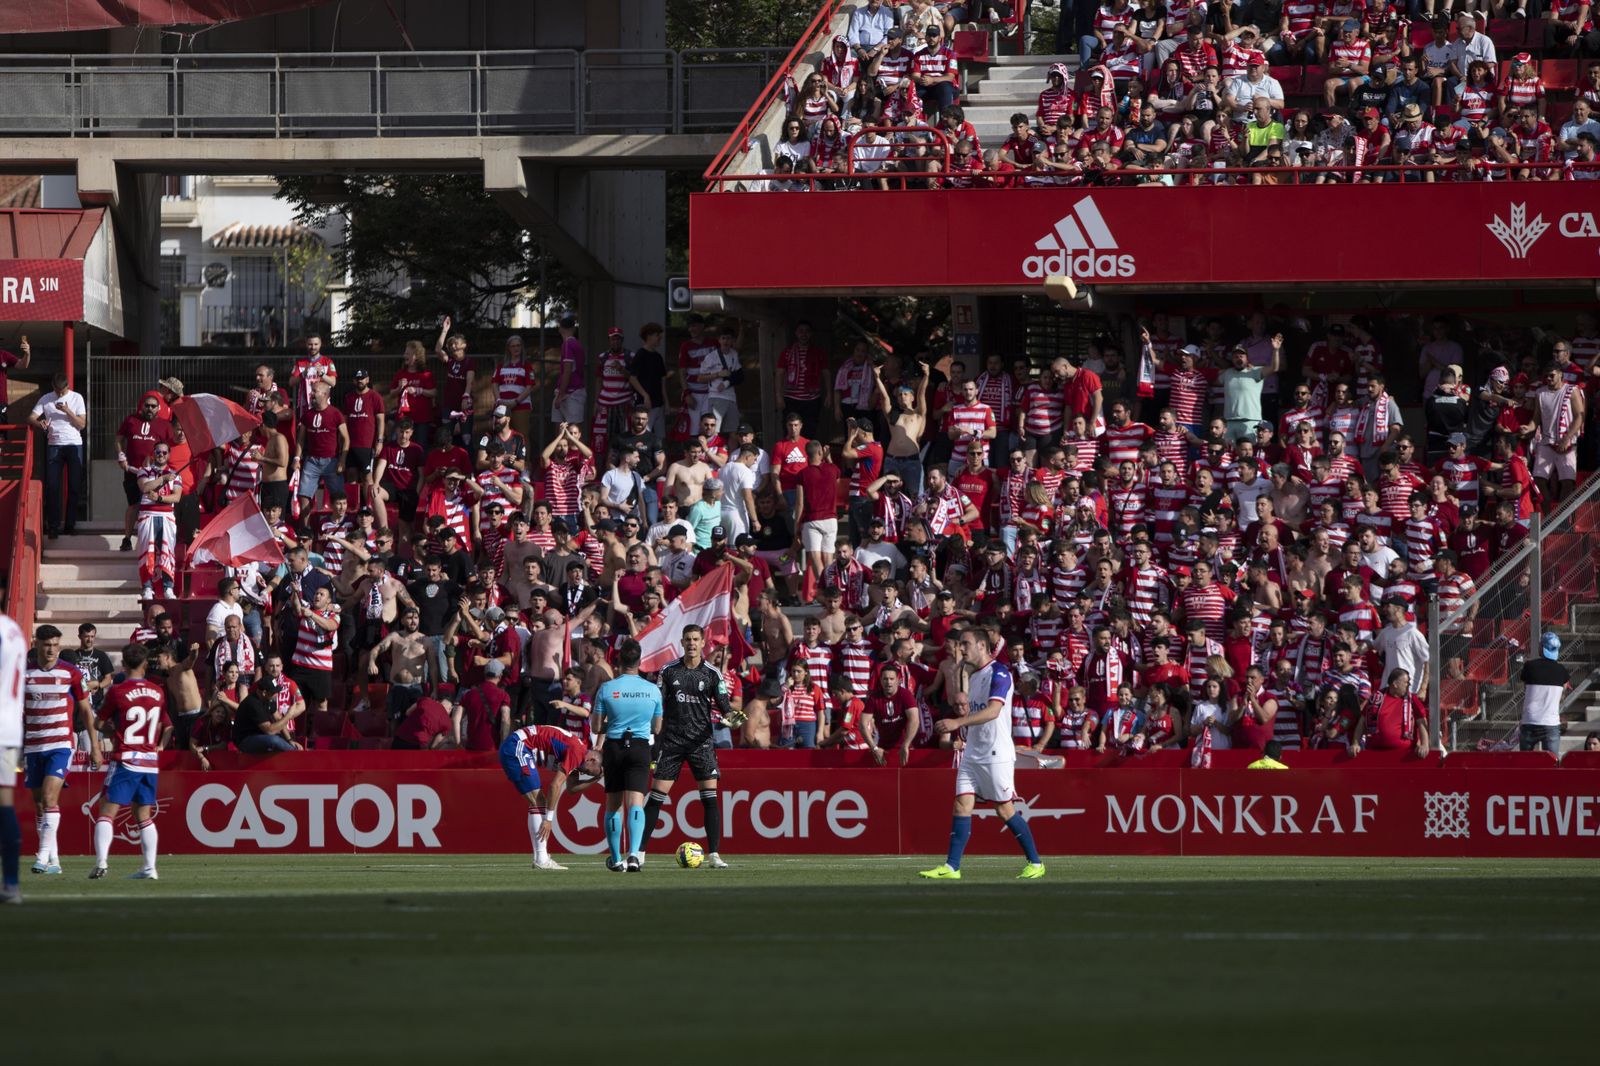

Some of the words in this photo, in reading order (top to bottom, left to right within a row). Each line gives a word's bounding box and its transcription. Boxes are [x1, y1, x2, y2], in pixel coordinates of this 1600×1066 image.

[1022, 249, 1136, 278] adidas
[3, 277, 36, 304] RA
[40, 277, 59, 292] SIN
[125, 687, 162, 702] MELENDO
[124, 706, 161, 745] 21
[186, 783, 442, 848] CASTOR
[1105, 794, 1379, 836] MONKRAF
